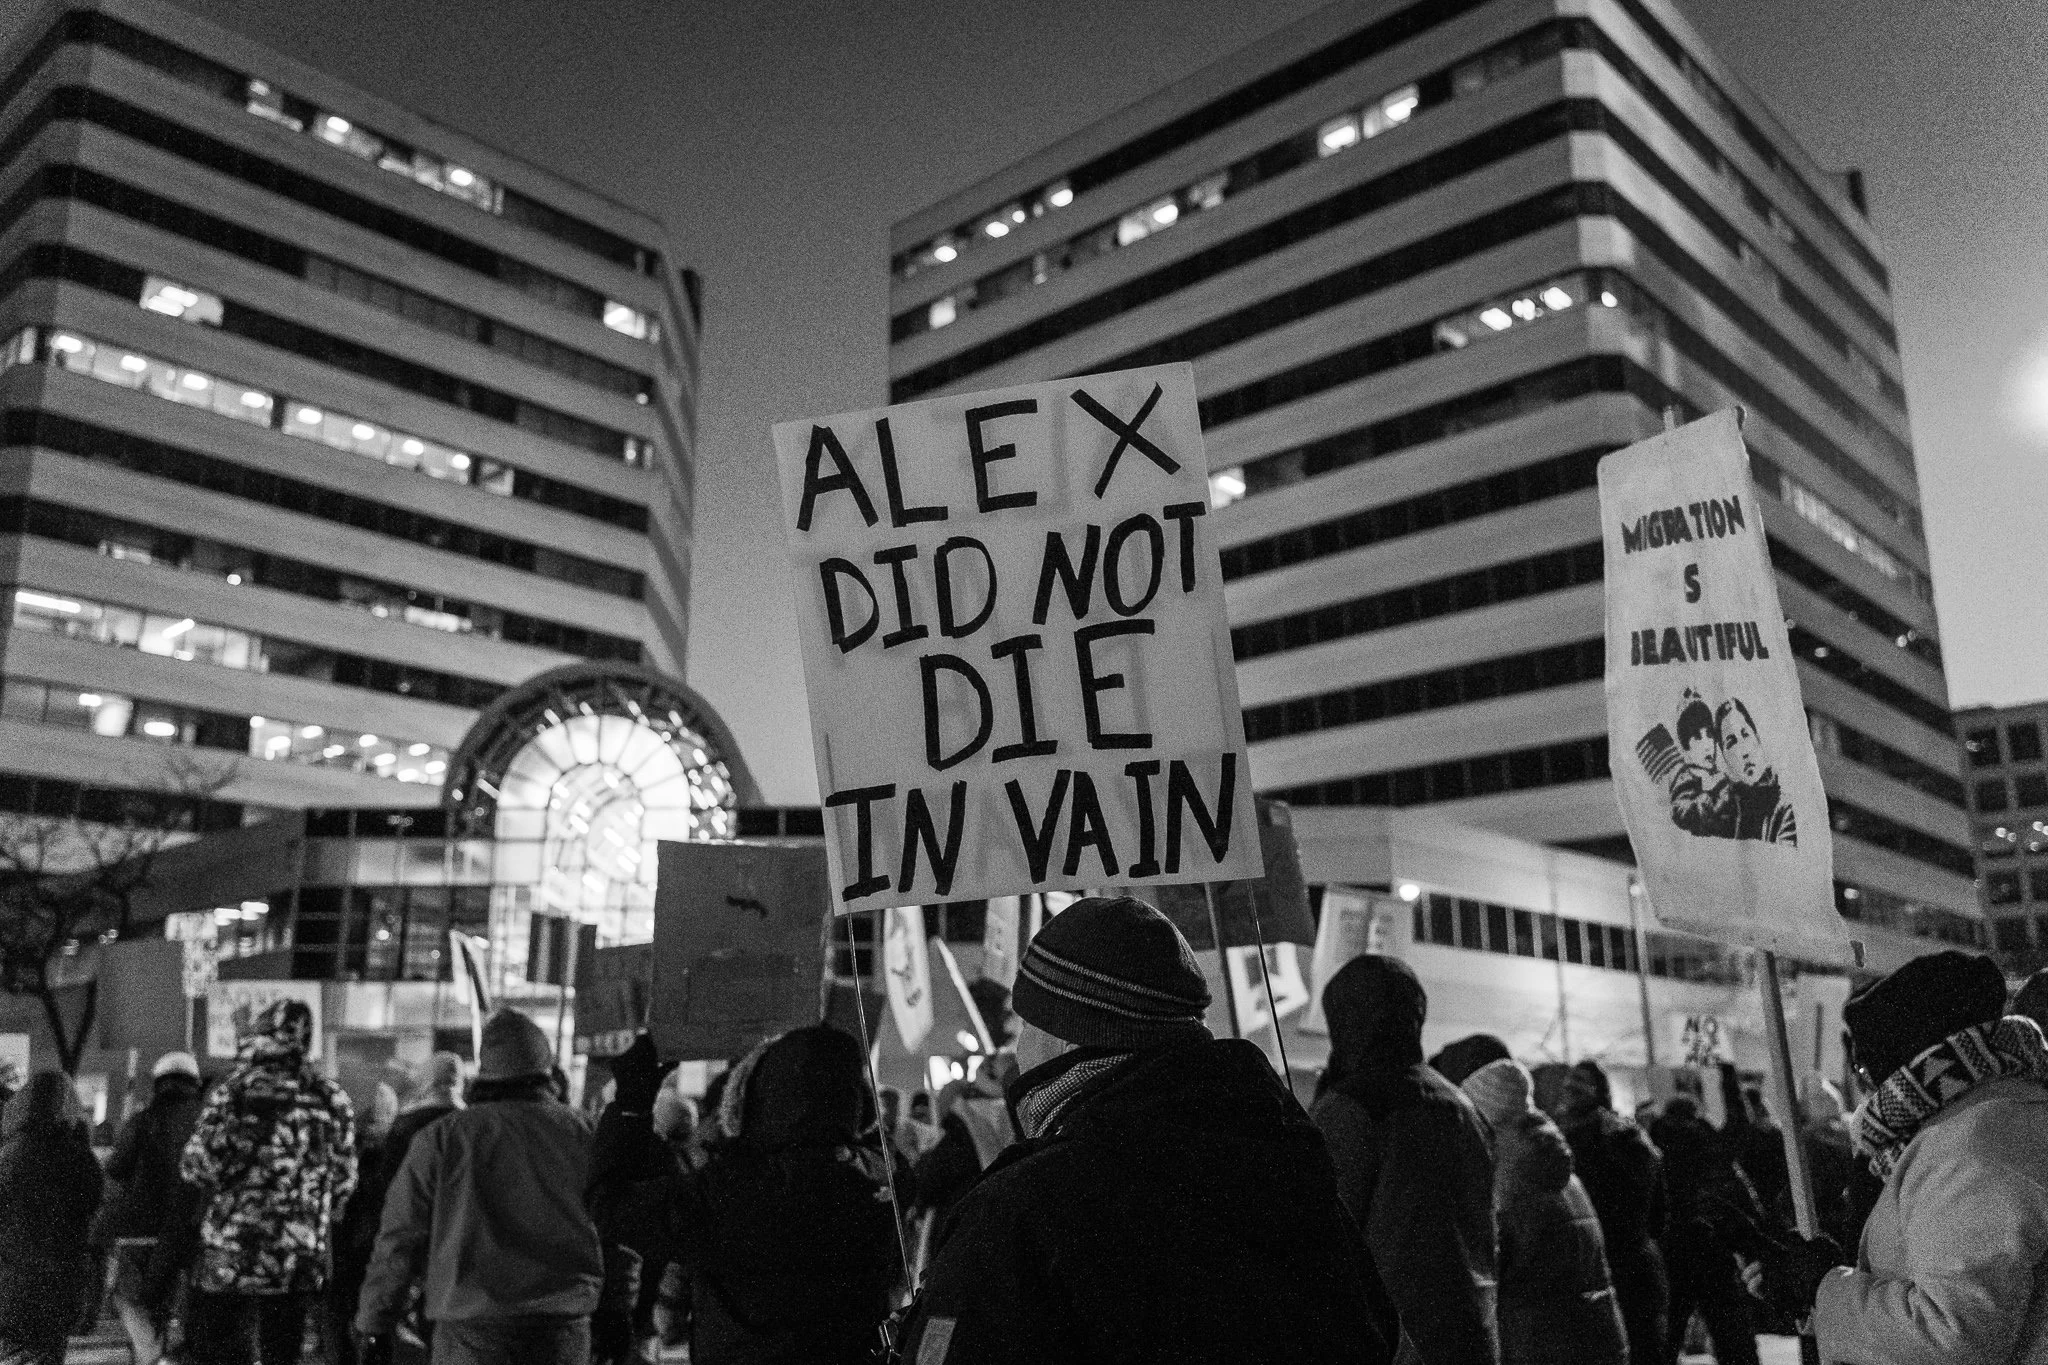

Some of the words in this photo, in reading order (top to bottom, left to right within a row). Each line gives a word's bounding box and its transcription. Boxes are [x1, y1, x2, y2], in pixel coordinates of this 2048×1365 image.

[796, 381, 1181, 531] ALEX
[819, 536, 998, 654] DID
[1032, 501, 1206, 625] NOT
[919, 618, 1155, 771] DIE
[825, 779, 967, 902] IN
[1004, 752, 1237, 884] VAIN
